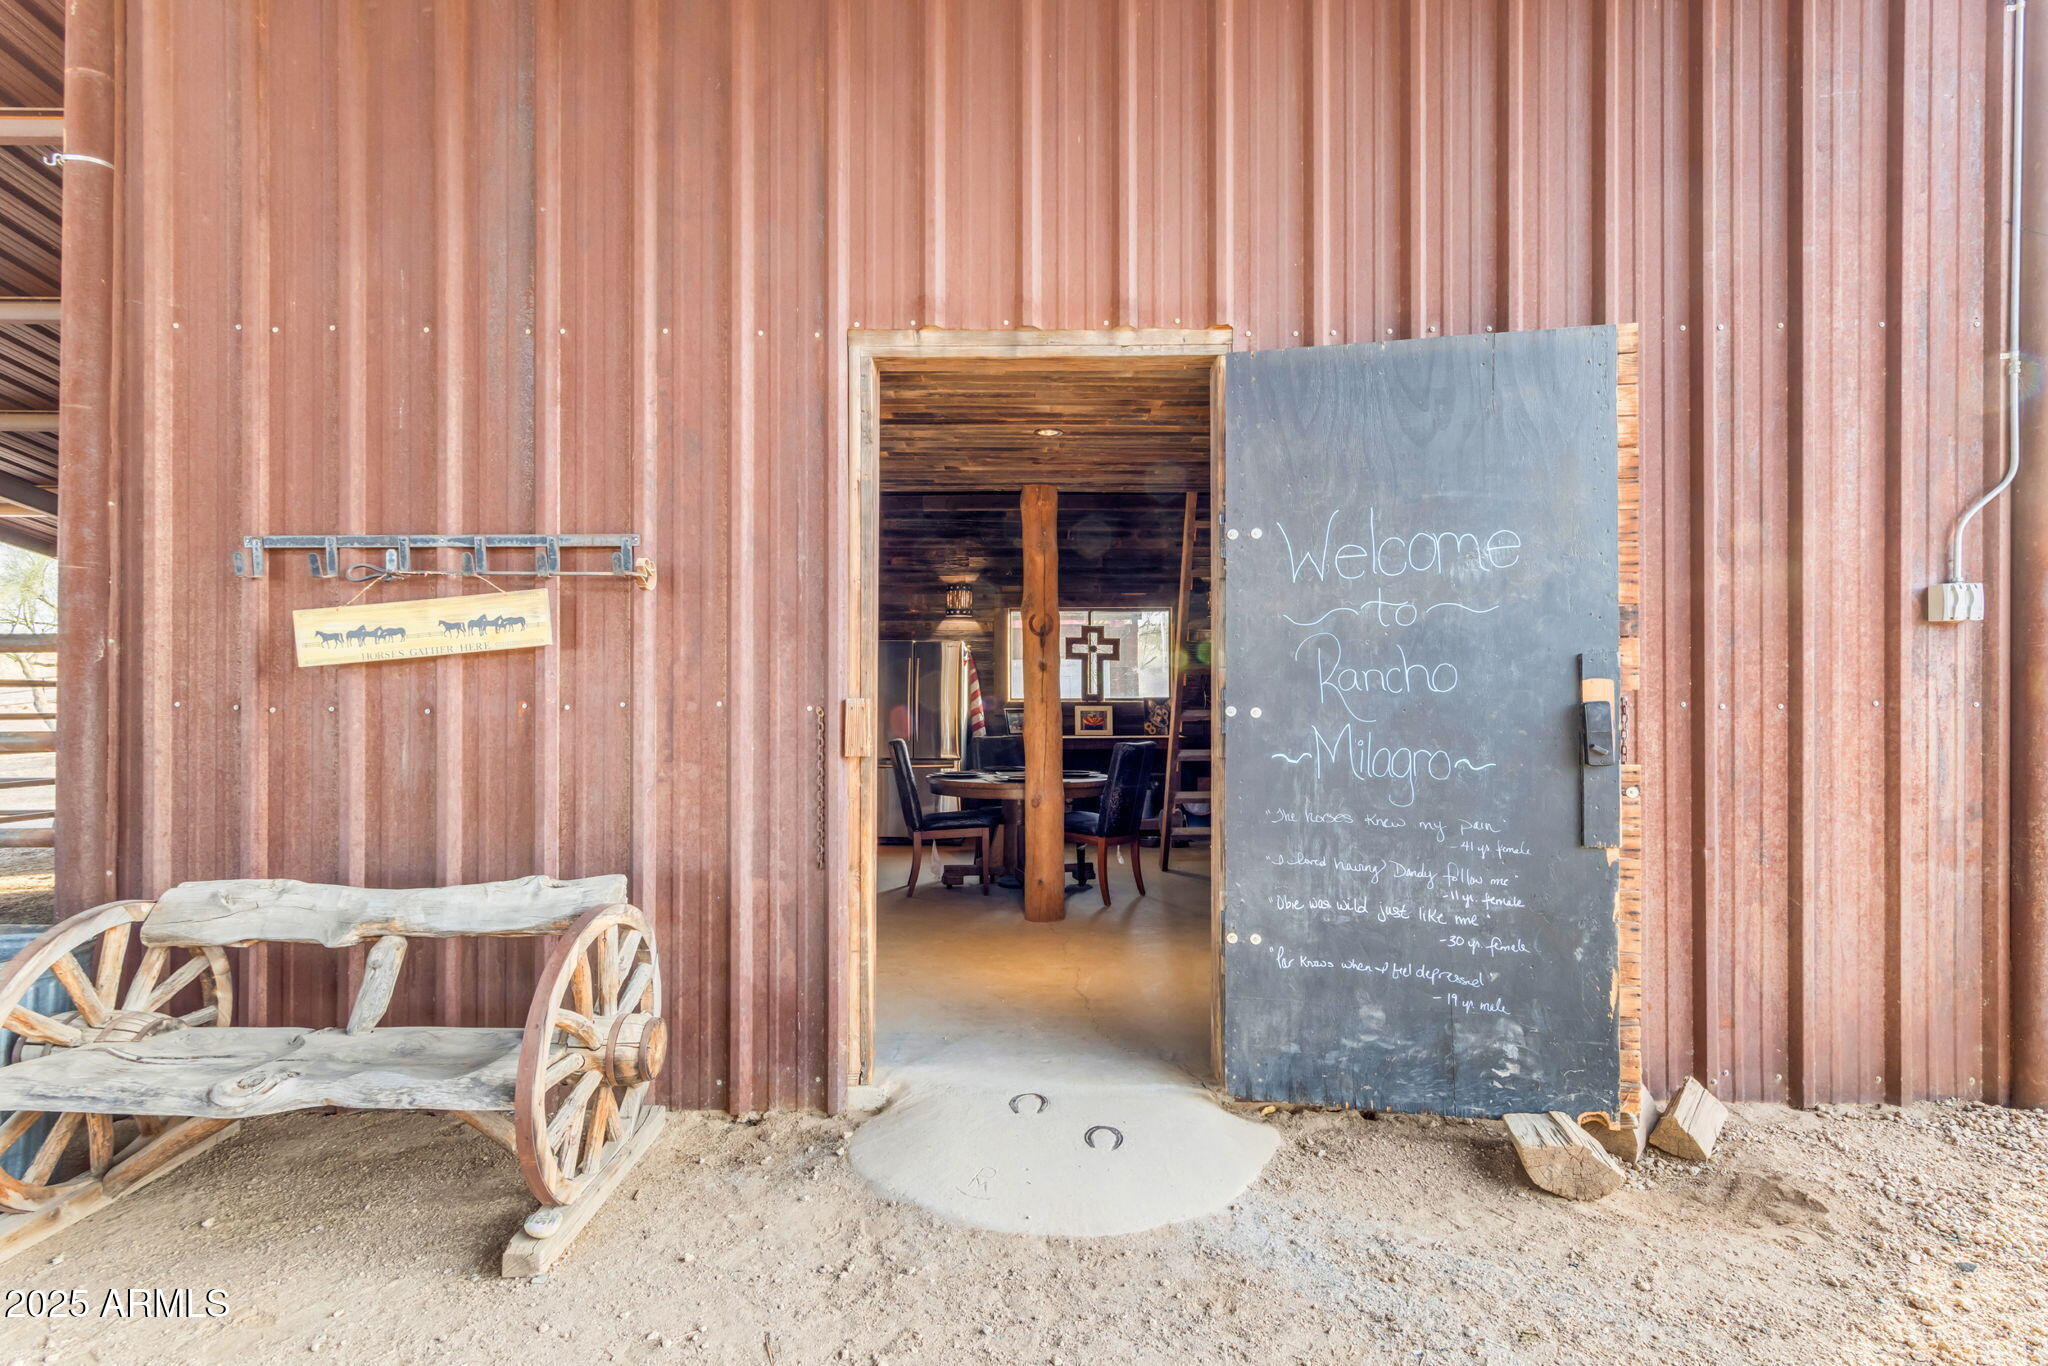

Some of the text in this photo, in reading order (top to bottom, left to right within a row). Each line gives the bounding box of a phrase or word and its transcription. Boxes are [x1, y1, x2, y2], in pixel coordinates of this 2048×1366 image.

[1276, 507, 1521, 583] Welcome
[361, 642, 490, 662] HORSES GATHER HERE
[1295, 632, 1458, 723] Rancho
[1311, 723, 1452, 808] Milagro
[1304, 809, 1354, 824] horses
[1419, 820, 1447, 843] my
[1496, 840, 1533, 860] female
[1286, 852, 1327, 867] loved
[1333, 856, 1387, 885] having
[1388, 859, 1438, 890] Dandy
[1443, 861, 1483, 888] follow
[1309, 897, 1332, 911] was
[1336, 897, 1369, 915] wild
[1377, 902, 1411, 923] just
[1481, 891, 1526, 911] female
[1485, 936, 1532, 958] female
[1341, 959, 1374, 973] when
[1392, 963, 1413, 980] feel
[1479, 997, 1511, 1015] male
